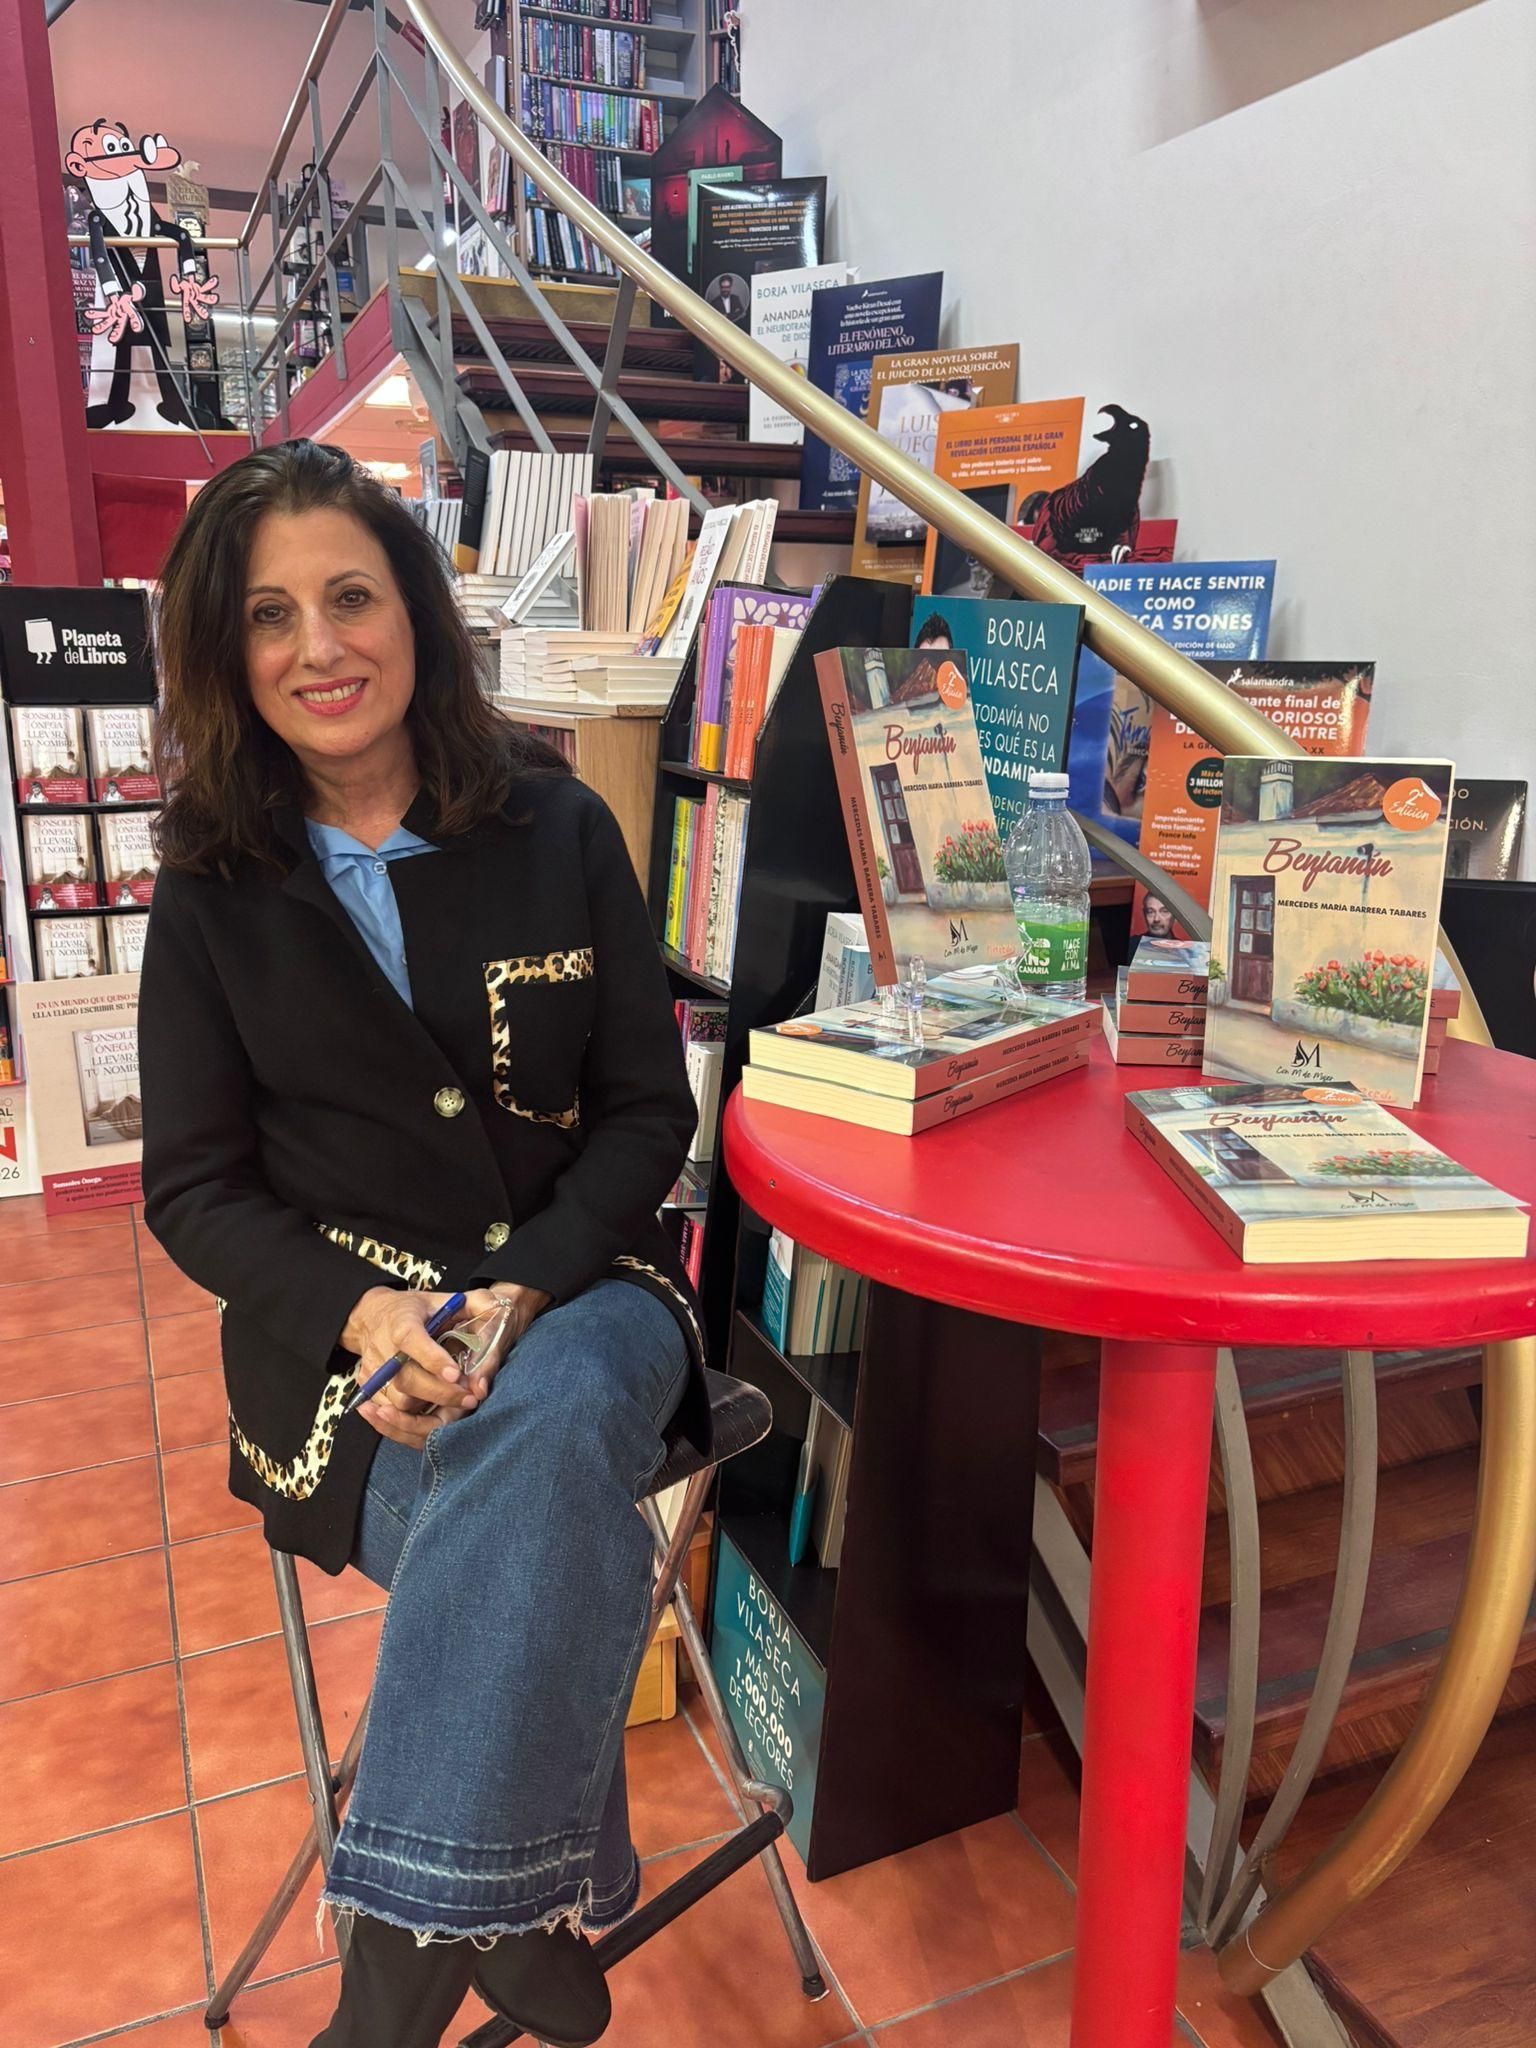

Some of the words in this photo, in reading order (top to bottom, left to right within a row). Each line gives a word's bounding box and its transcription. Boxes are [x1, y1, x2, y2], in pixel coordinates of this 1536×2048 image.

[757, 287, 788, 299] BORJA
[792, 279, 840, 294] VILASECA
[840, 332, 850, 343] EL
[852, 326, 904, 342] FENÓMENO
[828, 342, 874, 356] LITERARIO
[874, 340, 891, 350] DEL
[890, 335, 915, 348] AÑO
[890, 359, 902, 368] LA
[904, 356, 930, 367] GRAN
[932, 354, 968, 366] NOVELA
[969, 350, 998, 361] SOBRE
[877, 371, 888, 380] EL
[888, 368, 920, 380] JUICIO
[922, 368, 934, 377] DE
[936, 367, 946, 376] LA
[948, 360, 1011, 376] INQUISICIÓN
[954, 440, 972, 448] LIBRO
[989, 434, 1022, 445] PERSONAL
[1024, 433, 1032, 441] DE
[1044, 431, 1064, 440] GRAN
[1138, 578, 1154, 590] TE
[1159, 577, 1202, 590] HACE
[1208, 576, 1266, 590] SENTIR
[1144, 597, 1196, 610] COMO
[1172, 614, 1253, 630] STONES
[62, 629, 122, 647] Planeta
[986, 618, 1046, 650] BORJA
[64, 647, 127, 664] deLibros
[969, 656, 1059, 695] VILASECA
[1242, 678, 1294, 687] salamandra
[1284, 694, 1318, 708] final
[1322, 693, 1340, 709] de
[975, 703, 1024, 730] TODAVÍA
[1028, 712, 1050, 734] NO
[883, 724, 958, 776] Benjamín
[995, 732, 1020, 756] QUÉ
[1024, 739, 1038, 758] ES
[1042, 742, 1056, 762] LA
[1190, 778, 1195, 786] 3
[851, 796, 862, 838] MERCEDES
[1262, 838, 1392, 892] Benjamín
[1278, 900, 1318, 910] MERCEDES
[1350, 905, 1388, 916] BARRERA
[1389, 908, 1427, 919] TABARES
[1018, 966, 1050, 975] CANARIA
[61, 998, 88, 1008] MUNDO
[80, 1005, 114, 1014] ESCRIBIR
[749, 1574, 792, 1653] BORJA
[736, 1592, 800, 1706] VILASECA
[745, 1647, 768, 1692] MÁS
[771, 1685, 785, 1719] DE
[736, 1658, 792, 1759] 1.000.000
[730, 1676, 742, 1708] DE
[744, 1699, 792, 1790] LECTORES
